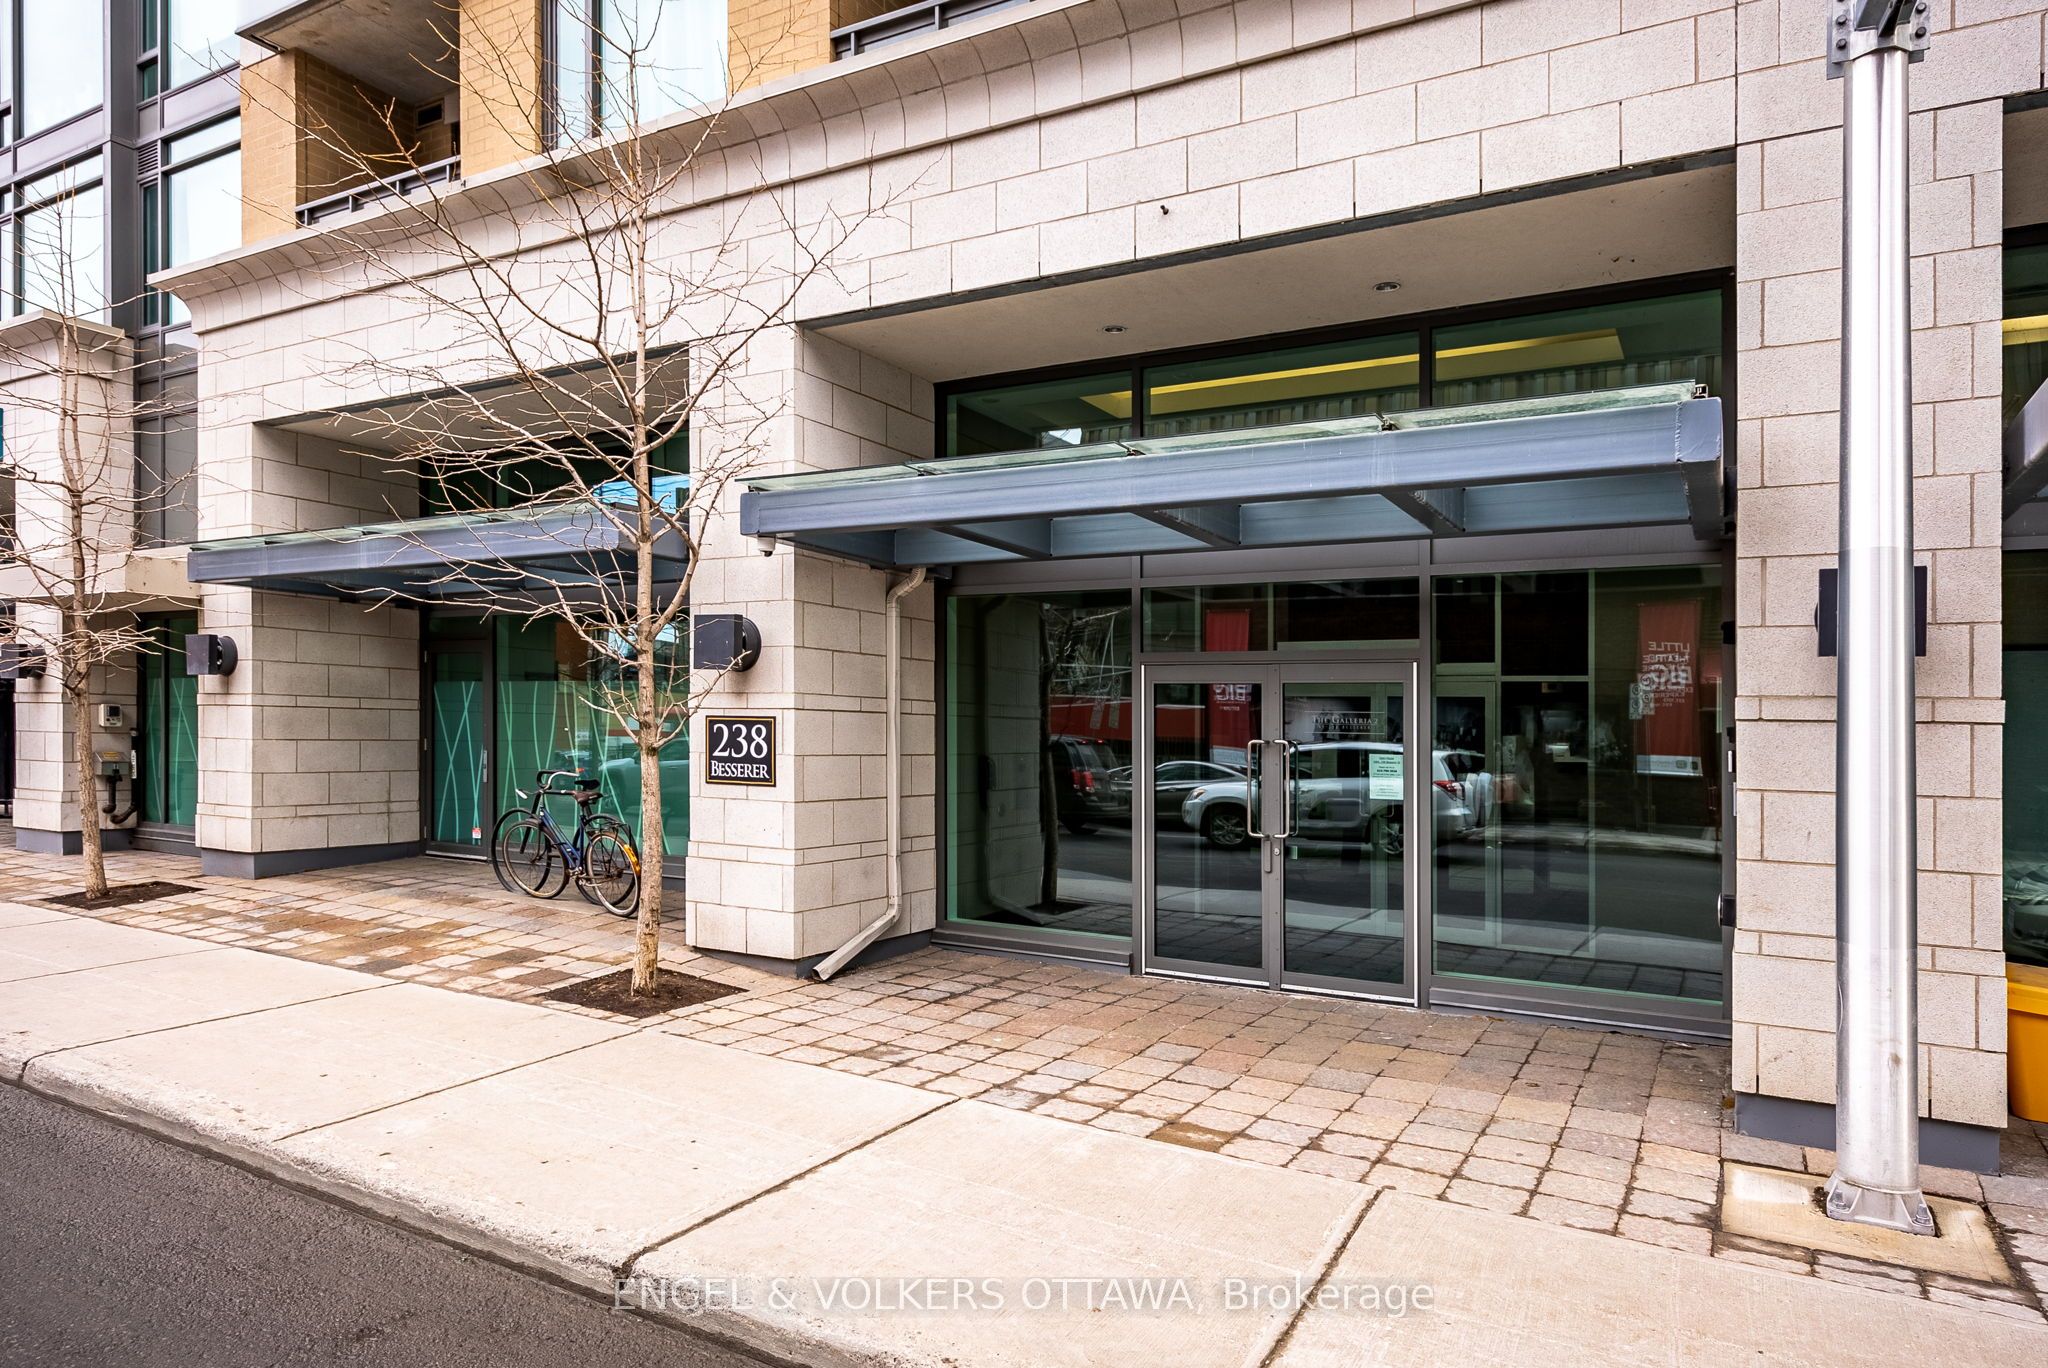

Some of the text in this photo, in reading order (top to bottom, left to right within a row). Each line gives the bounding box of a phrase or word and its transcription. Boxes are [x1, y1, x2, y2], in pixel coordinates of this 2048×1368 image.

[1332, 714, 1372, 724] GALLERIA
[712, 723, 768, 758] 238
[711, 760, 770, 779] BESSERER
